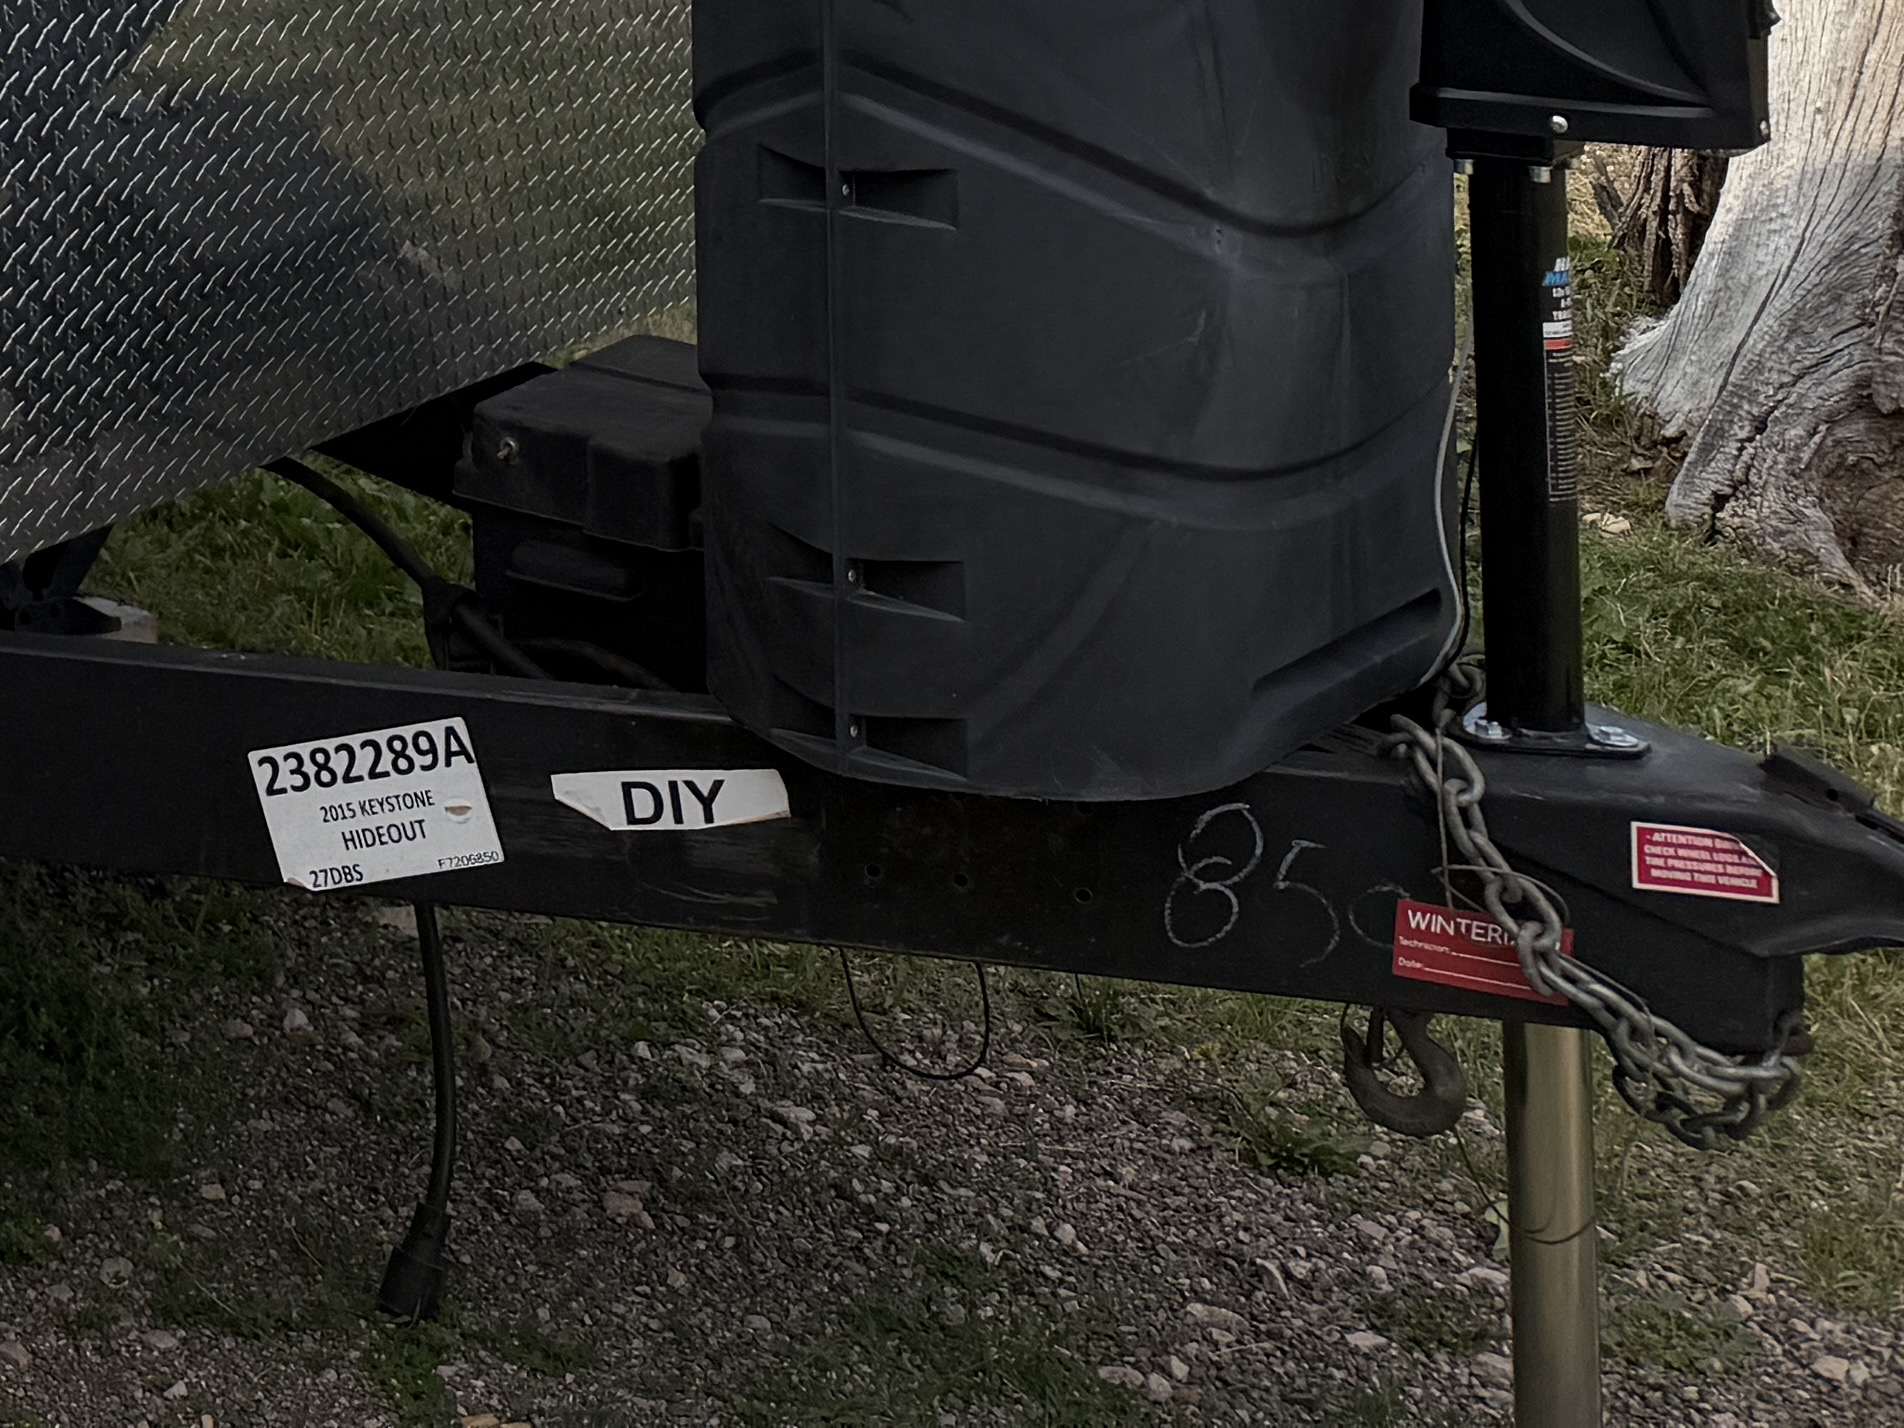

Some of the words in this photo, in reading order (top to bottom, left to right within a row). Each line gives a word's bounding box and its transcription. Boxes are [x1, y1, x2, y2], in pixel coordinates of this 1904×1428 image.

[257, 725, 475, 797] 2382289A
[319, 805, 357, 823] 2015
[358, 789, 435, 816] KEYSTONE
[621, 779, 725, 825] DIY
[341, 819, 427, 851] HIDEOUT
[308, 863, 364, 889] 27DBS
